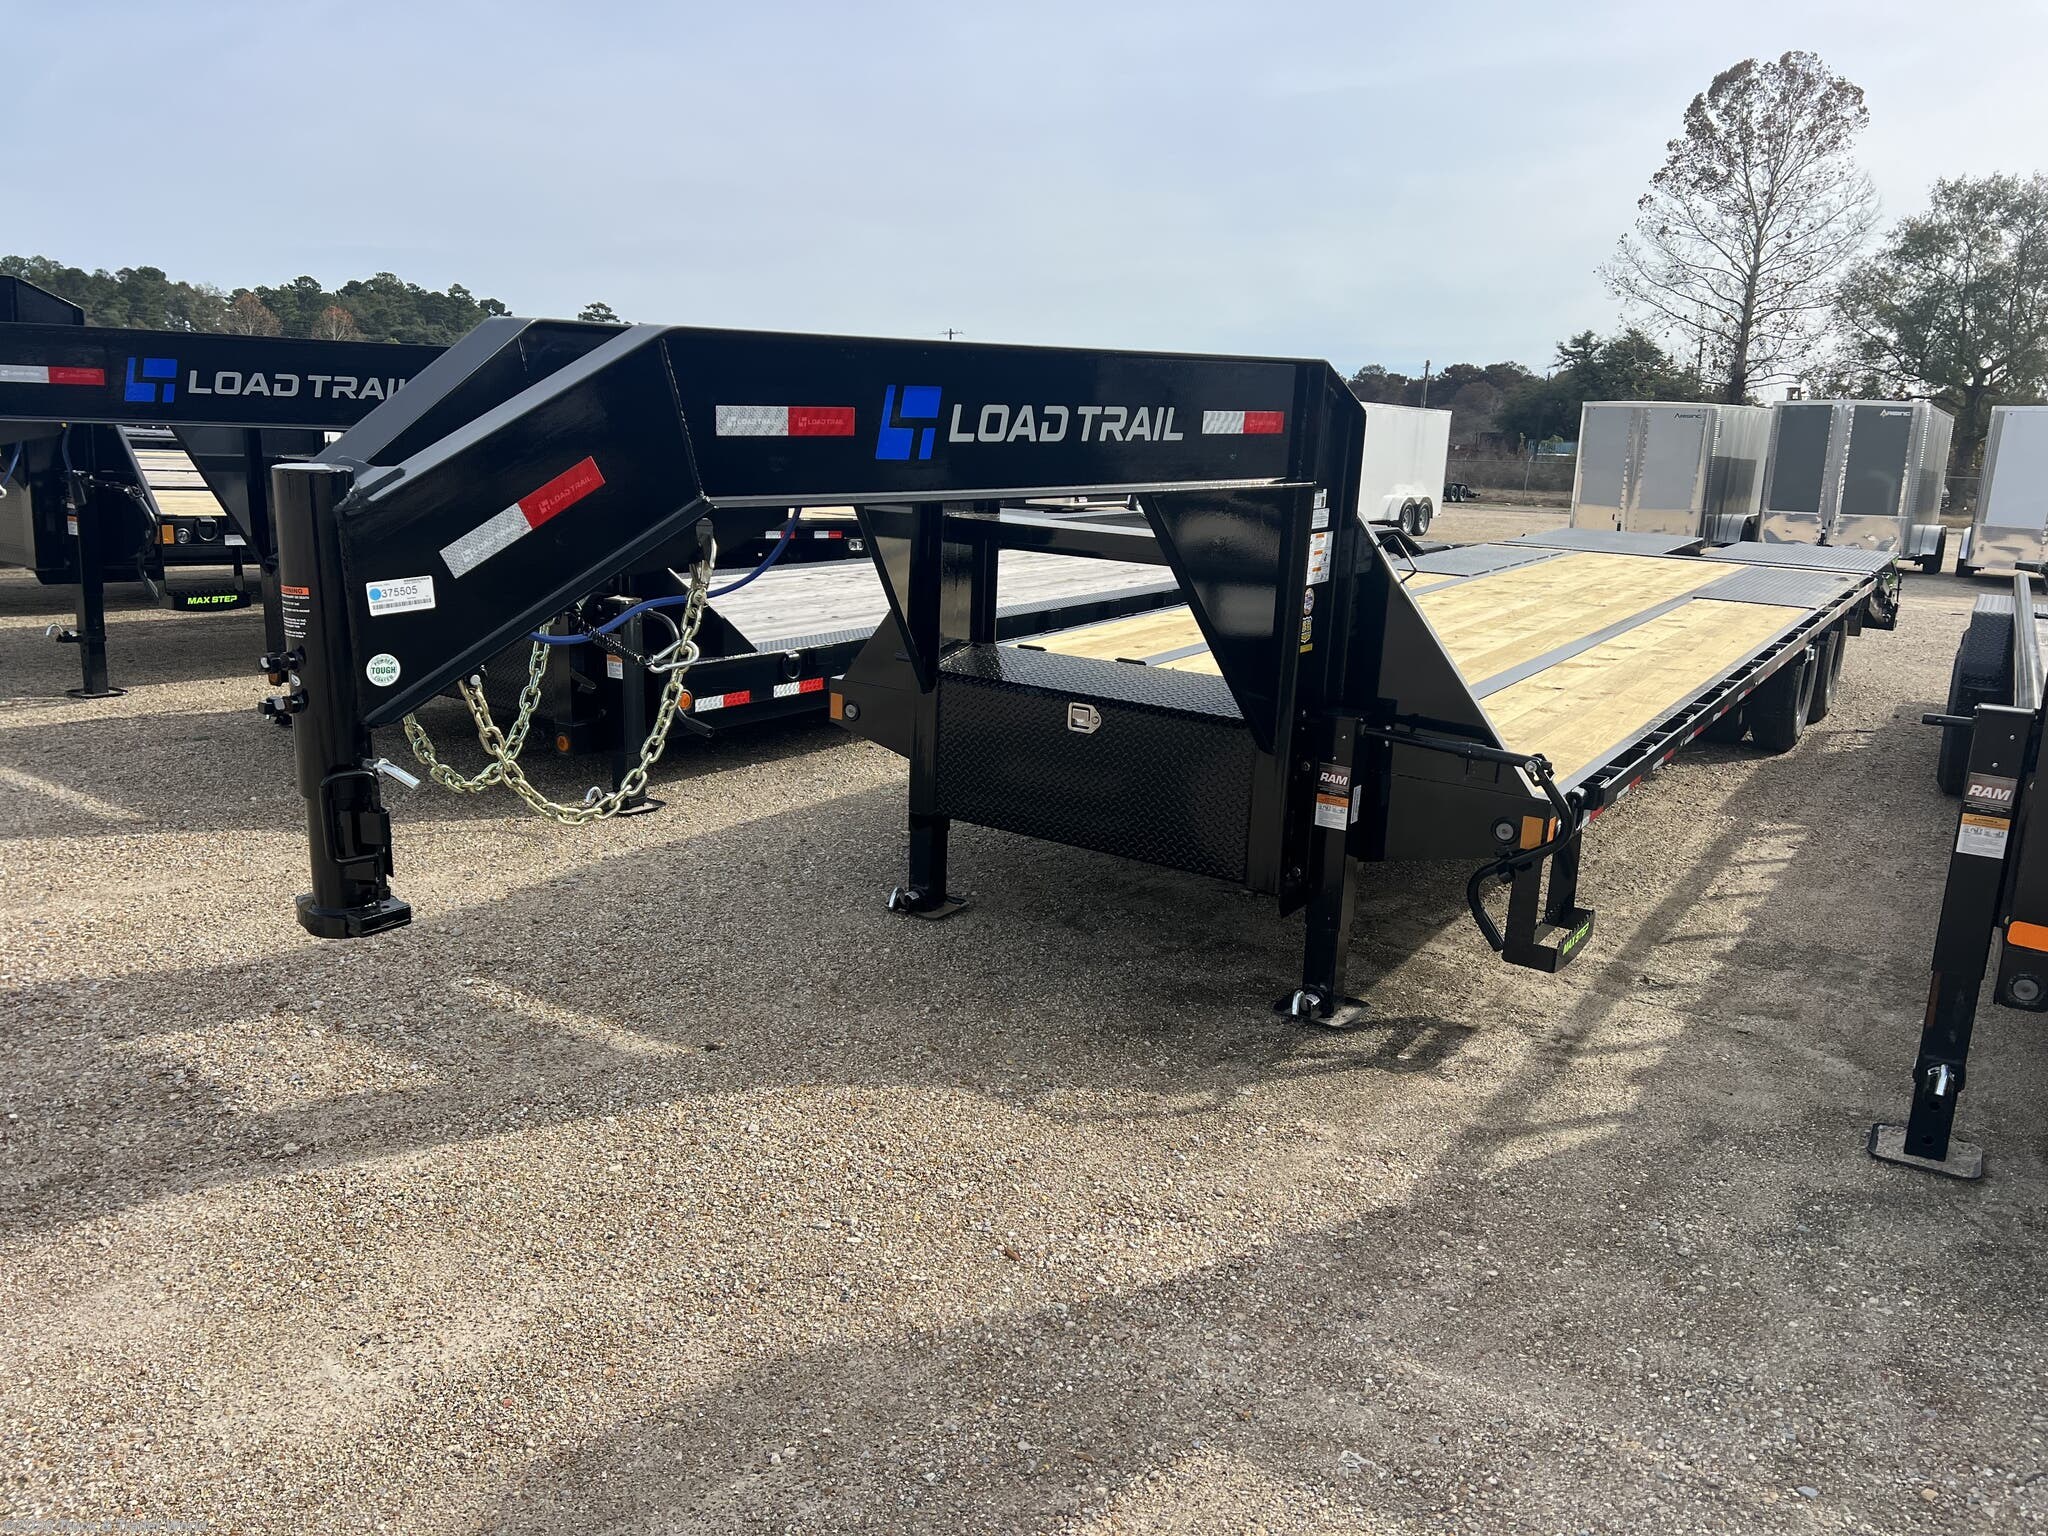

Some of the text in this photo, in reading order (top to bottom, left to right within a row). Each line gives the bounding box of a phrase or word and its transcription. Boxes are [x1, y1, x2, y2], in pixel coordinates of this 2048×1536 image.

[188, 370, 300, 397] LOAD
[949, 404, 1184, 442] LOAD TRAIL
[381, 586, 418, 598] 375505
[187, 595, 238, 605] MAX STEP
[371, 666, 396, 674] TOUGH
[1320, 772, 1348, 786] RAM
[1968, 784, 2012, 801] RAM
[1563, 936, 1575, 955] MAX
